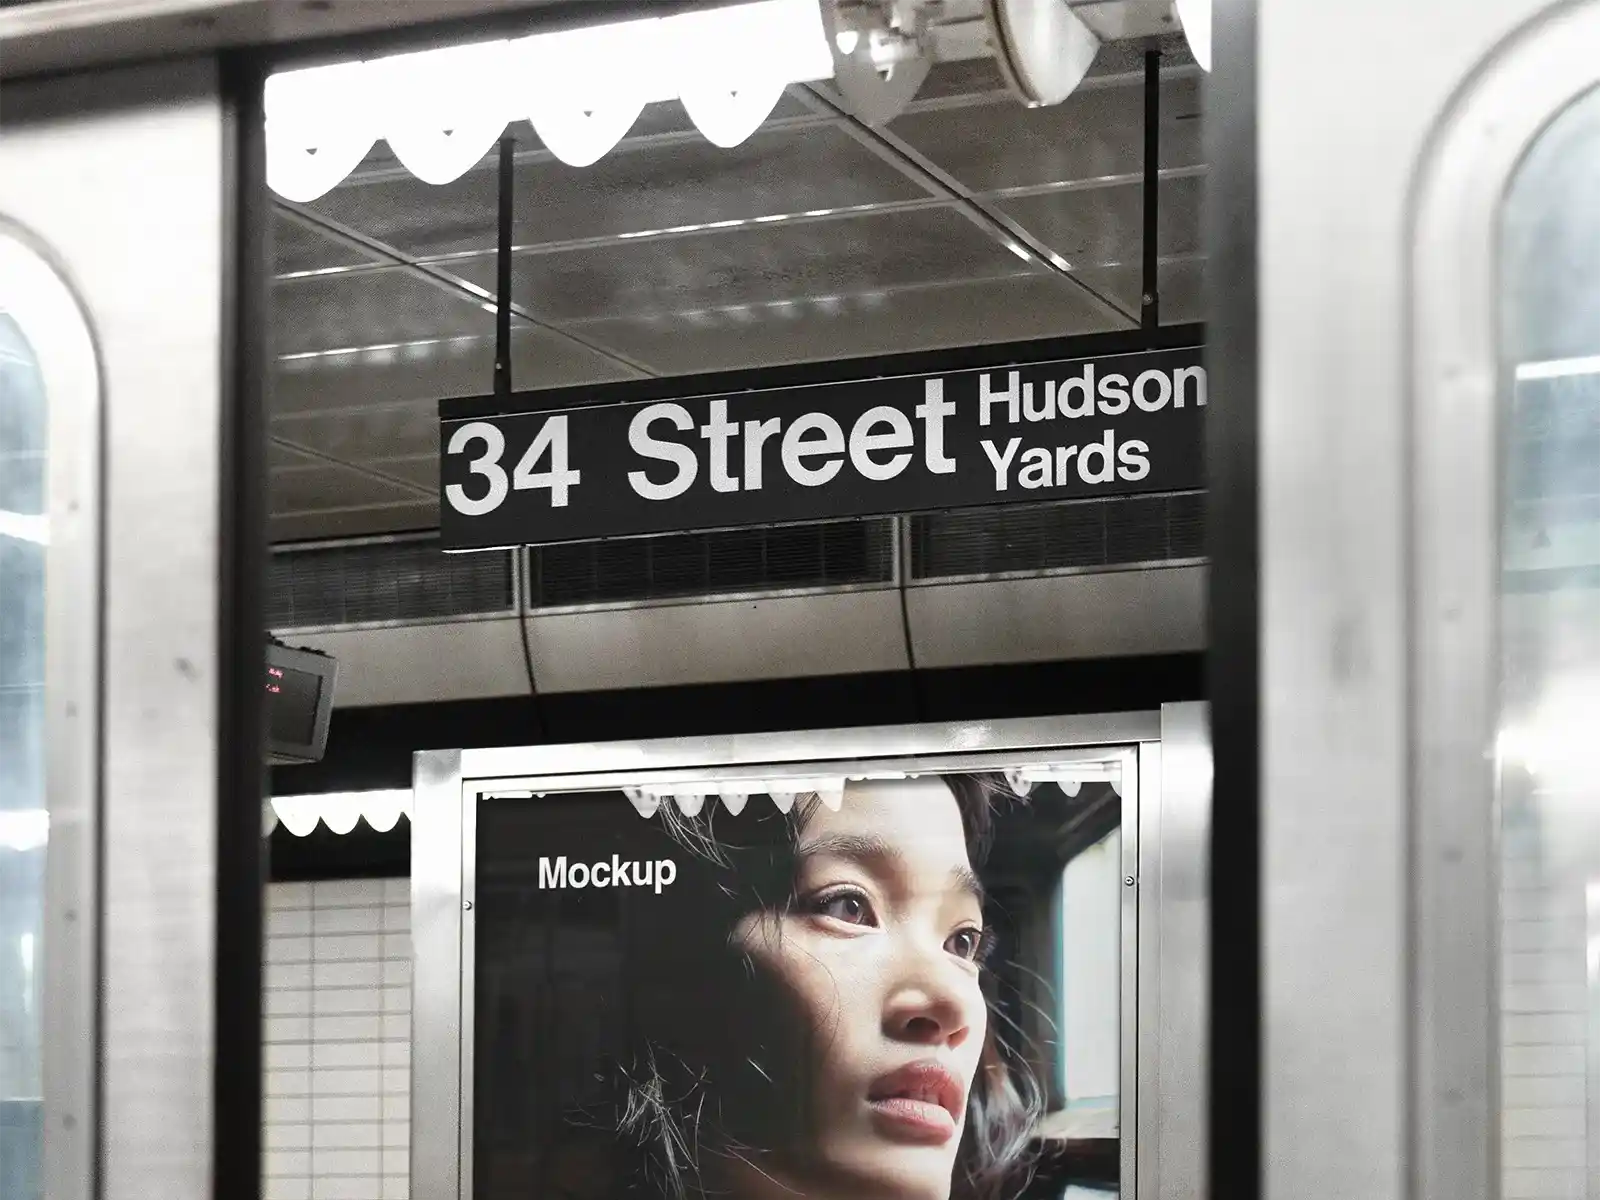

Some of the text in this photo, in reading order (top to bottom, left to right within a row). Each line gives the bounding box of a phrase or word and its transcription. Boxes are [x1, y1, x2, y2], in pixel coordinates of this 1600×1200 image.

[980, 364, 1207, 425] Hudson
[446, 379, 956, 515] 34 Street
[980, 429, 1150, 491] Yards
[539, 854, 676, 894] Mockup
